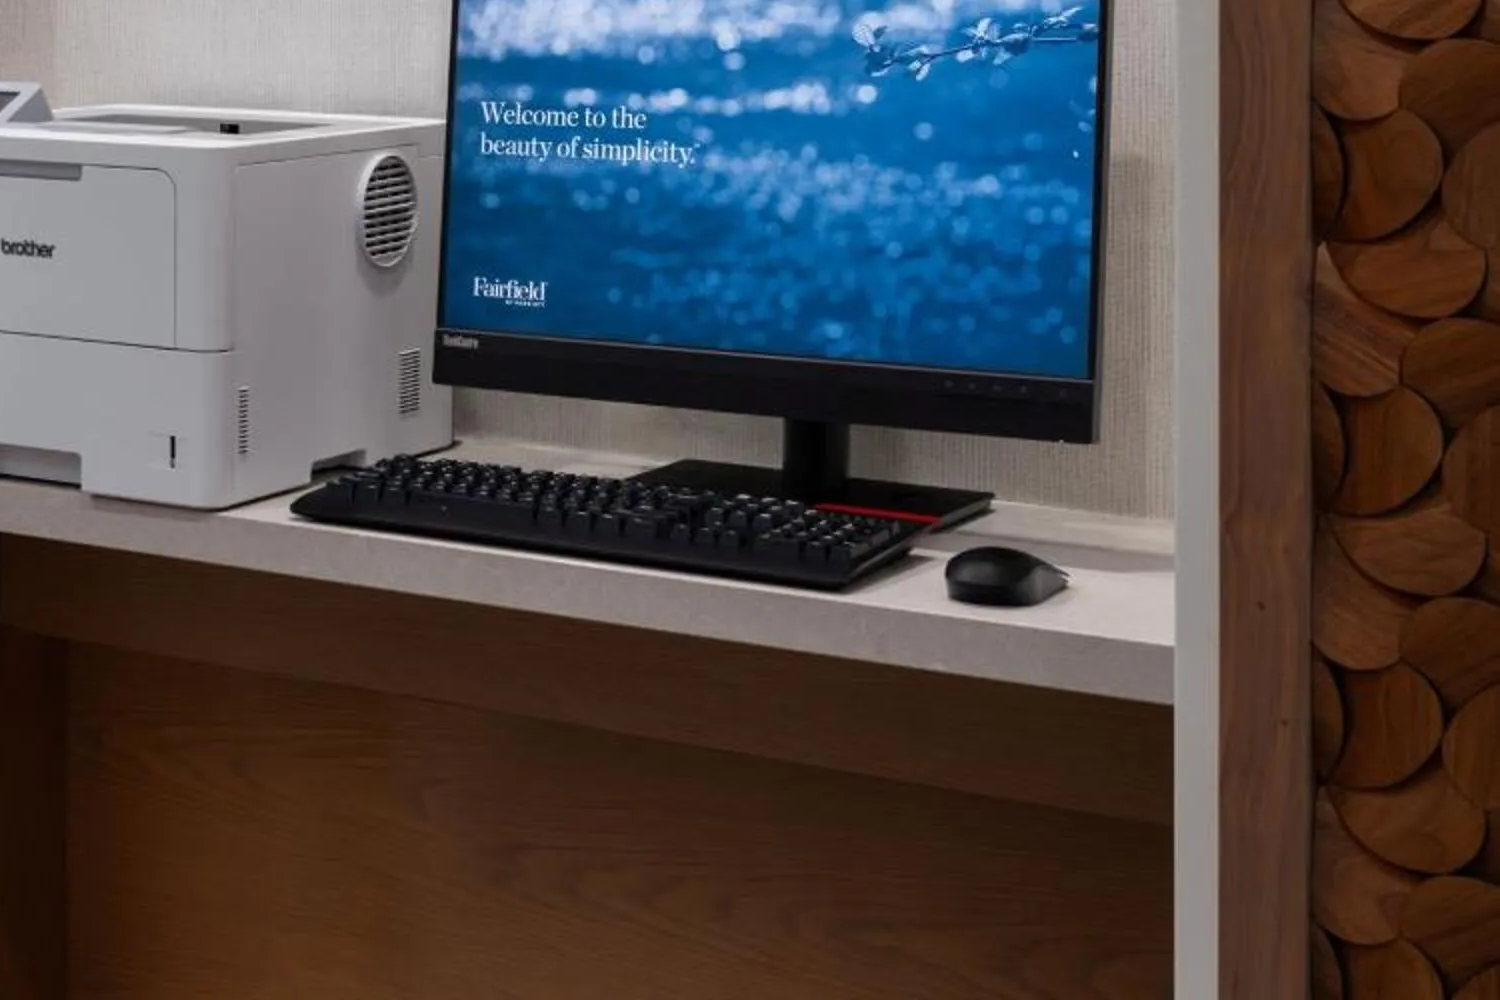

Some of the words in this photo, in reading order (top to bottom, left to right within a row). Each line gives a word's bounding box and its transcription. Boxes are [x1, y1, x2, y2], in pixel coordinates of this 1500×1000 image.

[481, 101, 579, 127] Welcome
[585, 107, 606, 129] to
[611, 105, 647, 129] the
[480, 132, 552, 162] beauty
[556, 136, 580, 156] of
[0, 238, 56, 260] brother
[473, 276, 546, 301] Fairfield
